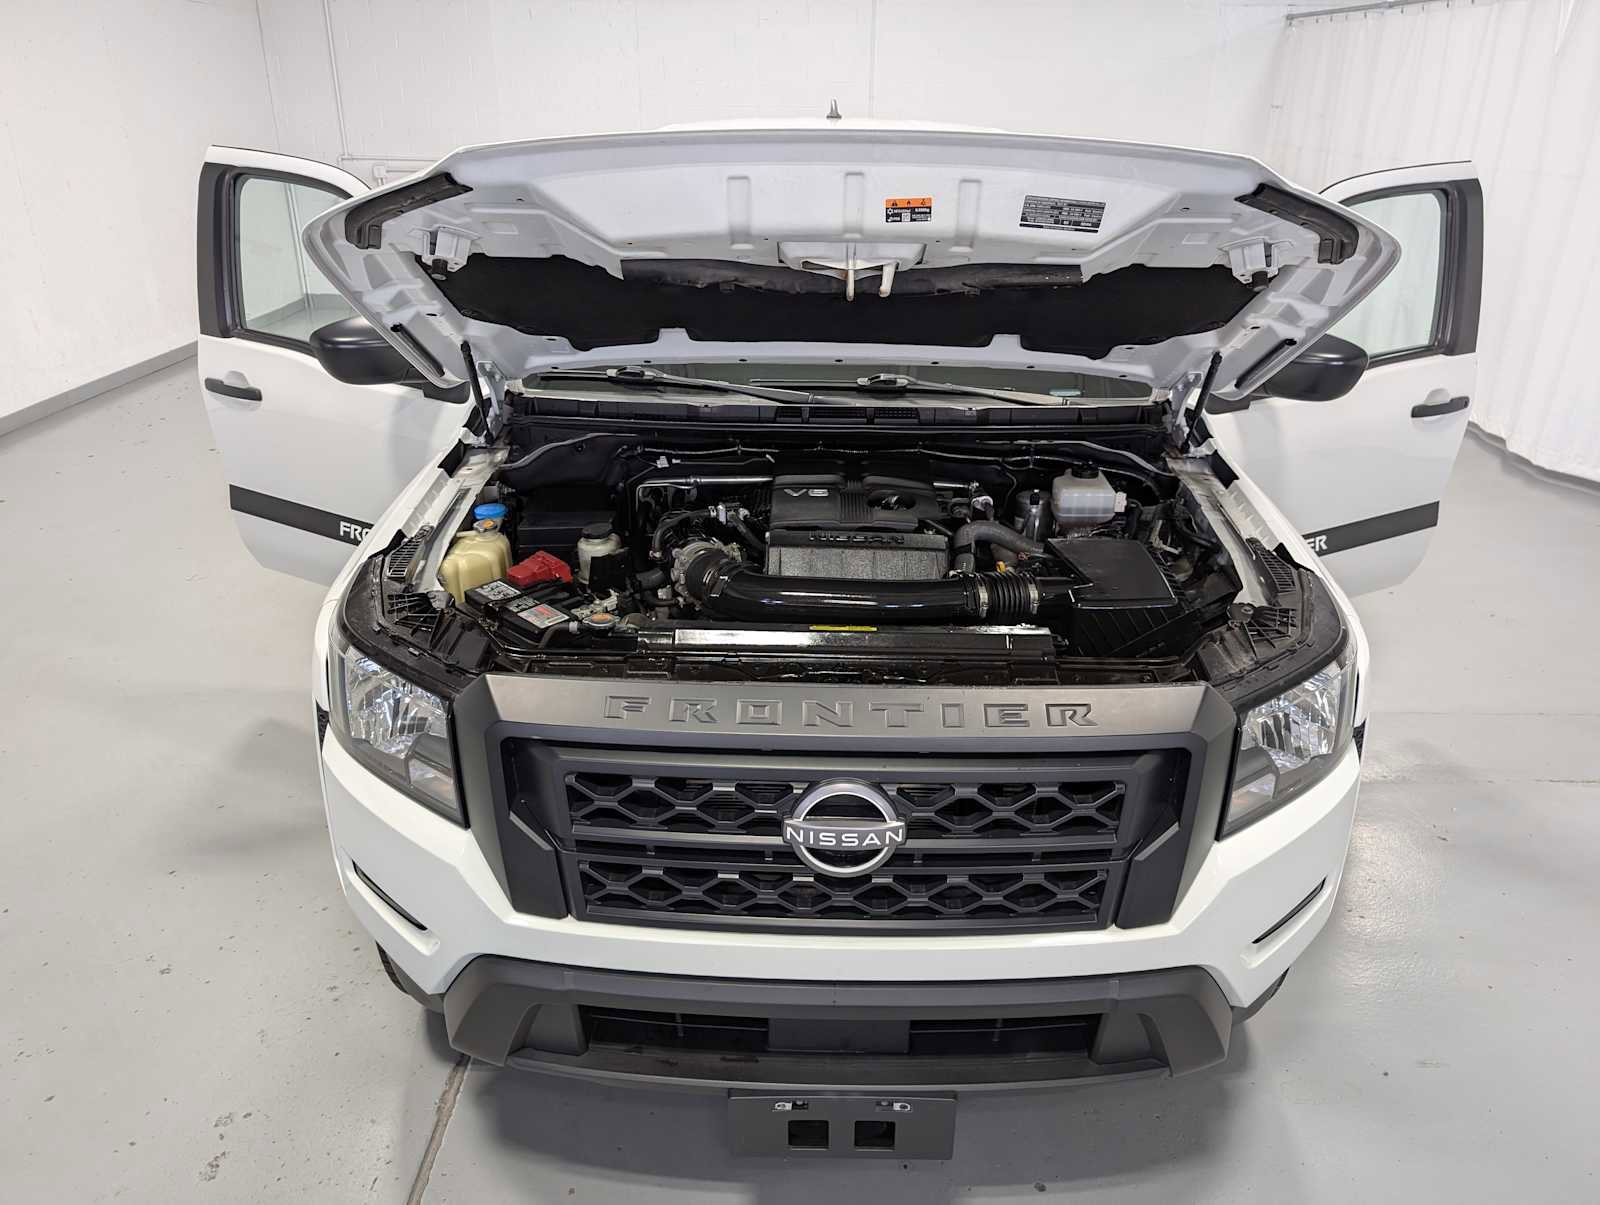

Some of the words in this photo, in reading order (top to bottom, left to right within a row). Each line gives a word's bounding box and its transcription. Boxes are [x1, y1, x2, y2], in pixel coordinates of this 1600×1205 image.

[784, 488, 829, 497] V6
[604, 695, 1098, 728] FRONTIER
[786, 826, 903, 846] NISSAN
